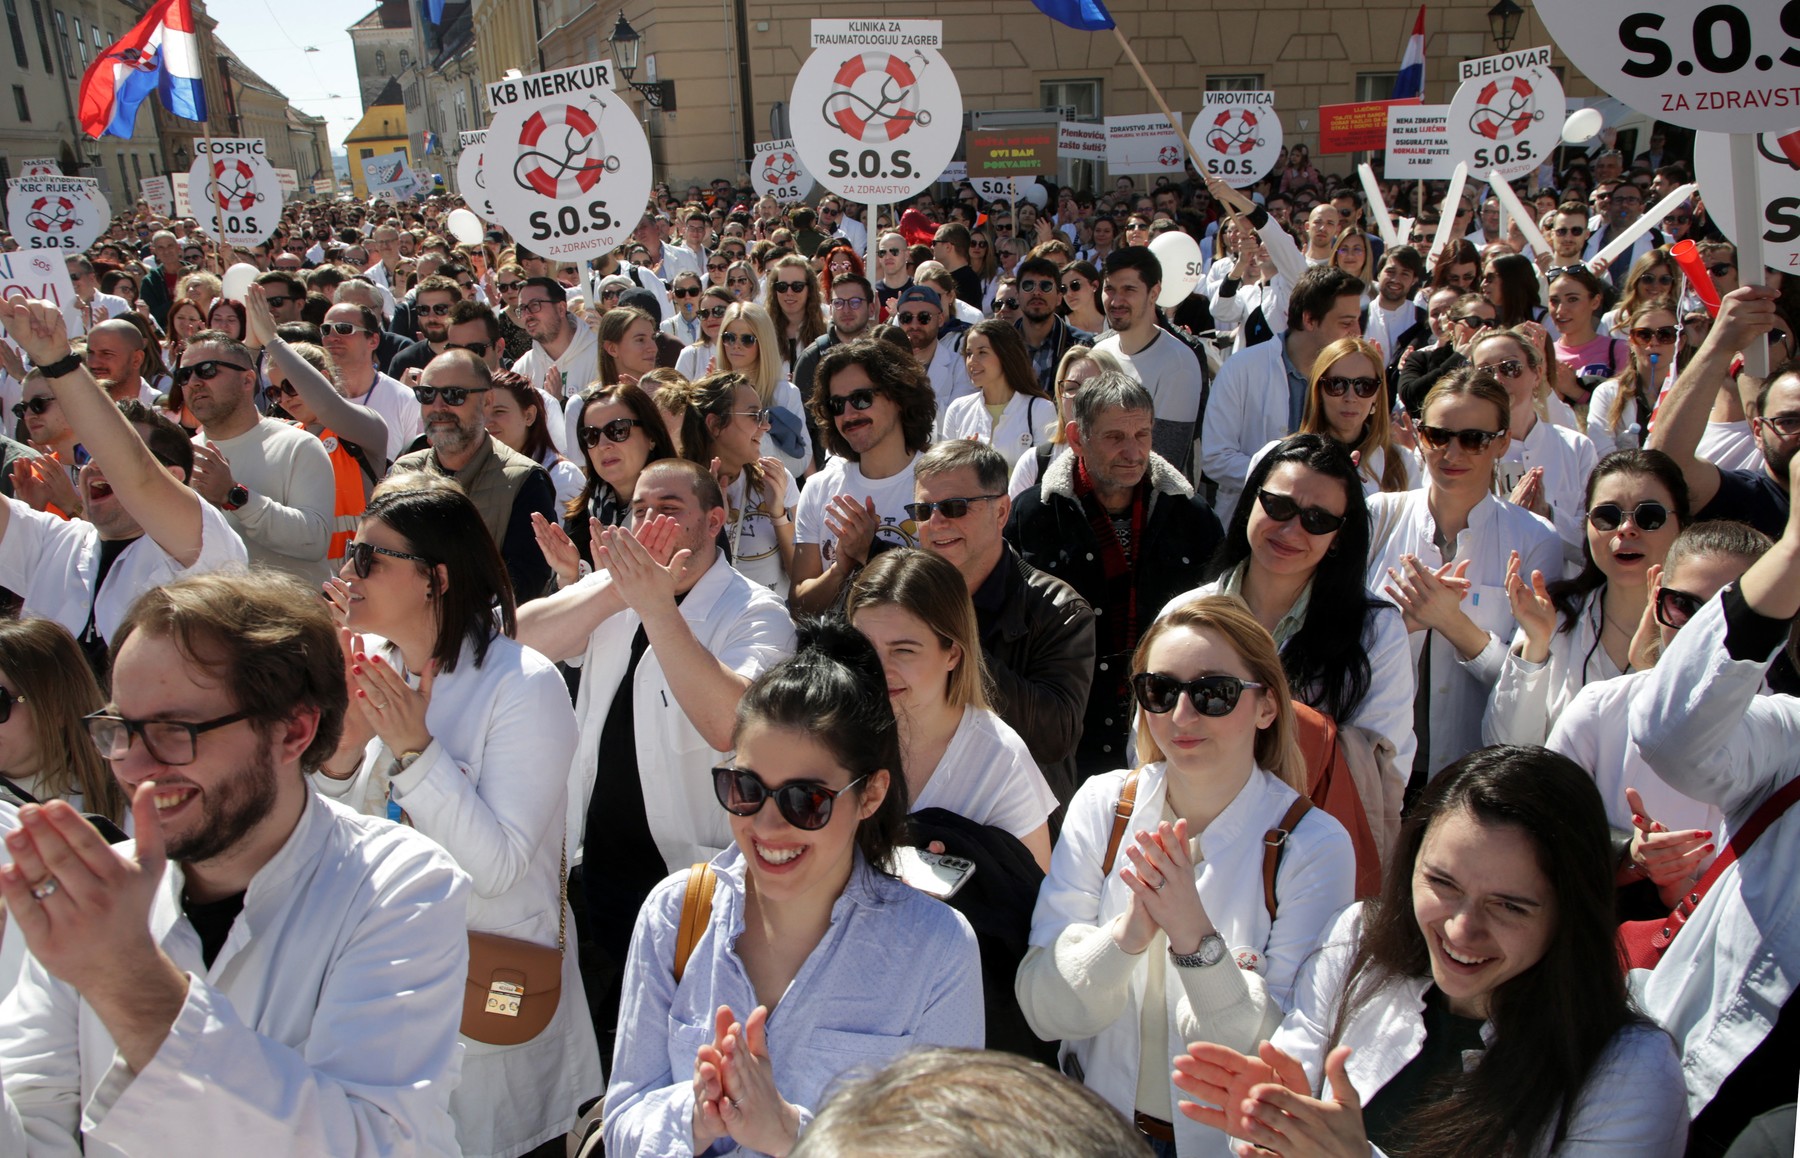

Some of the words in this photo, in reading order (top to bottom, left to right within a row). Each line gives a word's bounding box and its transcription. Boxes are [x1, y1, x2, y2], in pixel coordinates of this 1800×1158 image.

[849, 21, 886, 32] KLINIKA
[888, 22, 901, 32] ZA
[814, 34, 899, 45] TRAUMATOLOGIJU
[901, 35, 938, 45] ZAGREB
[1463, 49, 1549, 79] BJELOVAR
[490, 83, 518, 107] KB
[522, 65, 610, 100] MERKUR
[1206, 92, 1273, 105] VIROVITICA
[1661, 93, 1690, 111] ZA
[1110, 125, 1146, 133] ZDRAVSTVO
[196, 140, 264, 154] GOSPIĆ
[990, 149, 1009, 158] OVI
[1011, 148, 1034, 157] DAN
[1059, 142, 1080, 150] zašto
[1082, 142, 1106, 152] šutiš?
[1473, 140, 1537, 168] S.O.S.
[828, 149, 920, 179] S.O.S.
[1207, 158, 1257, 175] S.O.S.
[20, 184, 42, 192] KBC
[46, 183, 84, 192] RIJEKA
[843, 185, 855, 194] ZA
[857, 185, 910, 194] ZDRAVSTVO
[529, 200, 621, 241] S.O.S.
[31, 236, 80, 249] S.O.S.
[549, 246, 562, 255] ZA
[563, 236, 614, 253] ZDRAVSTVO
[32, 258, 52, 272] SOS
